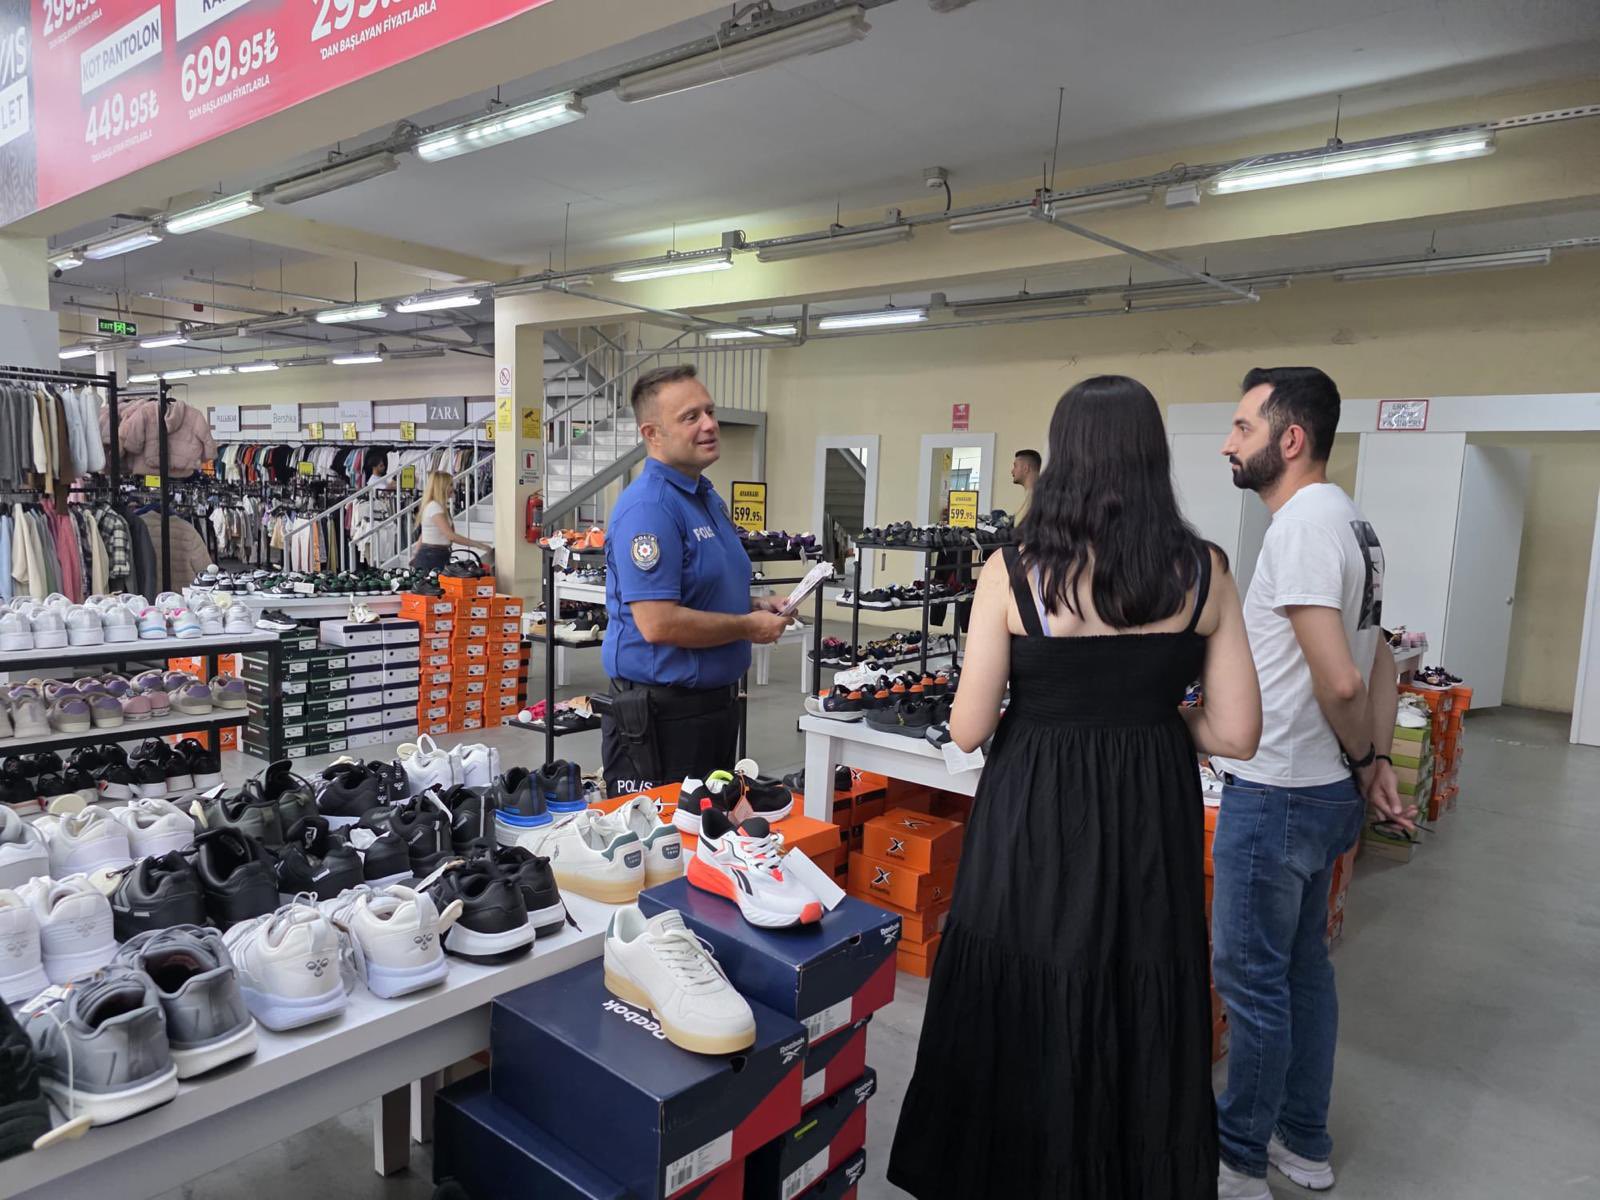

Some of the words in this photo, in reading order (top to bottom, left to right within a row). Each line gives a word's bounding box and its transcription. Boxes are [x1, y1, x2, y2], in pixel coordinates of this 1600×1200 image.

[83, 54, 102, 81] KOT
[103, 19, 160, 71] PANTOLON
[340, 22, 382, 51] BAŞLAYAN
[383, 0, 437, 33] FİYATLARLA
[181, 28, 279, 102] 699.95₺
[85, 89, 159, 146] 449.95₺
[100, 321, 114, 330] EXIT
[430, 406, 460, 420] ZARA
